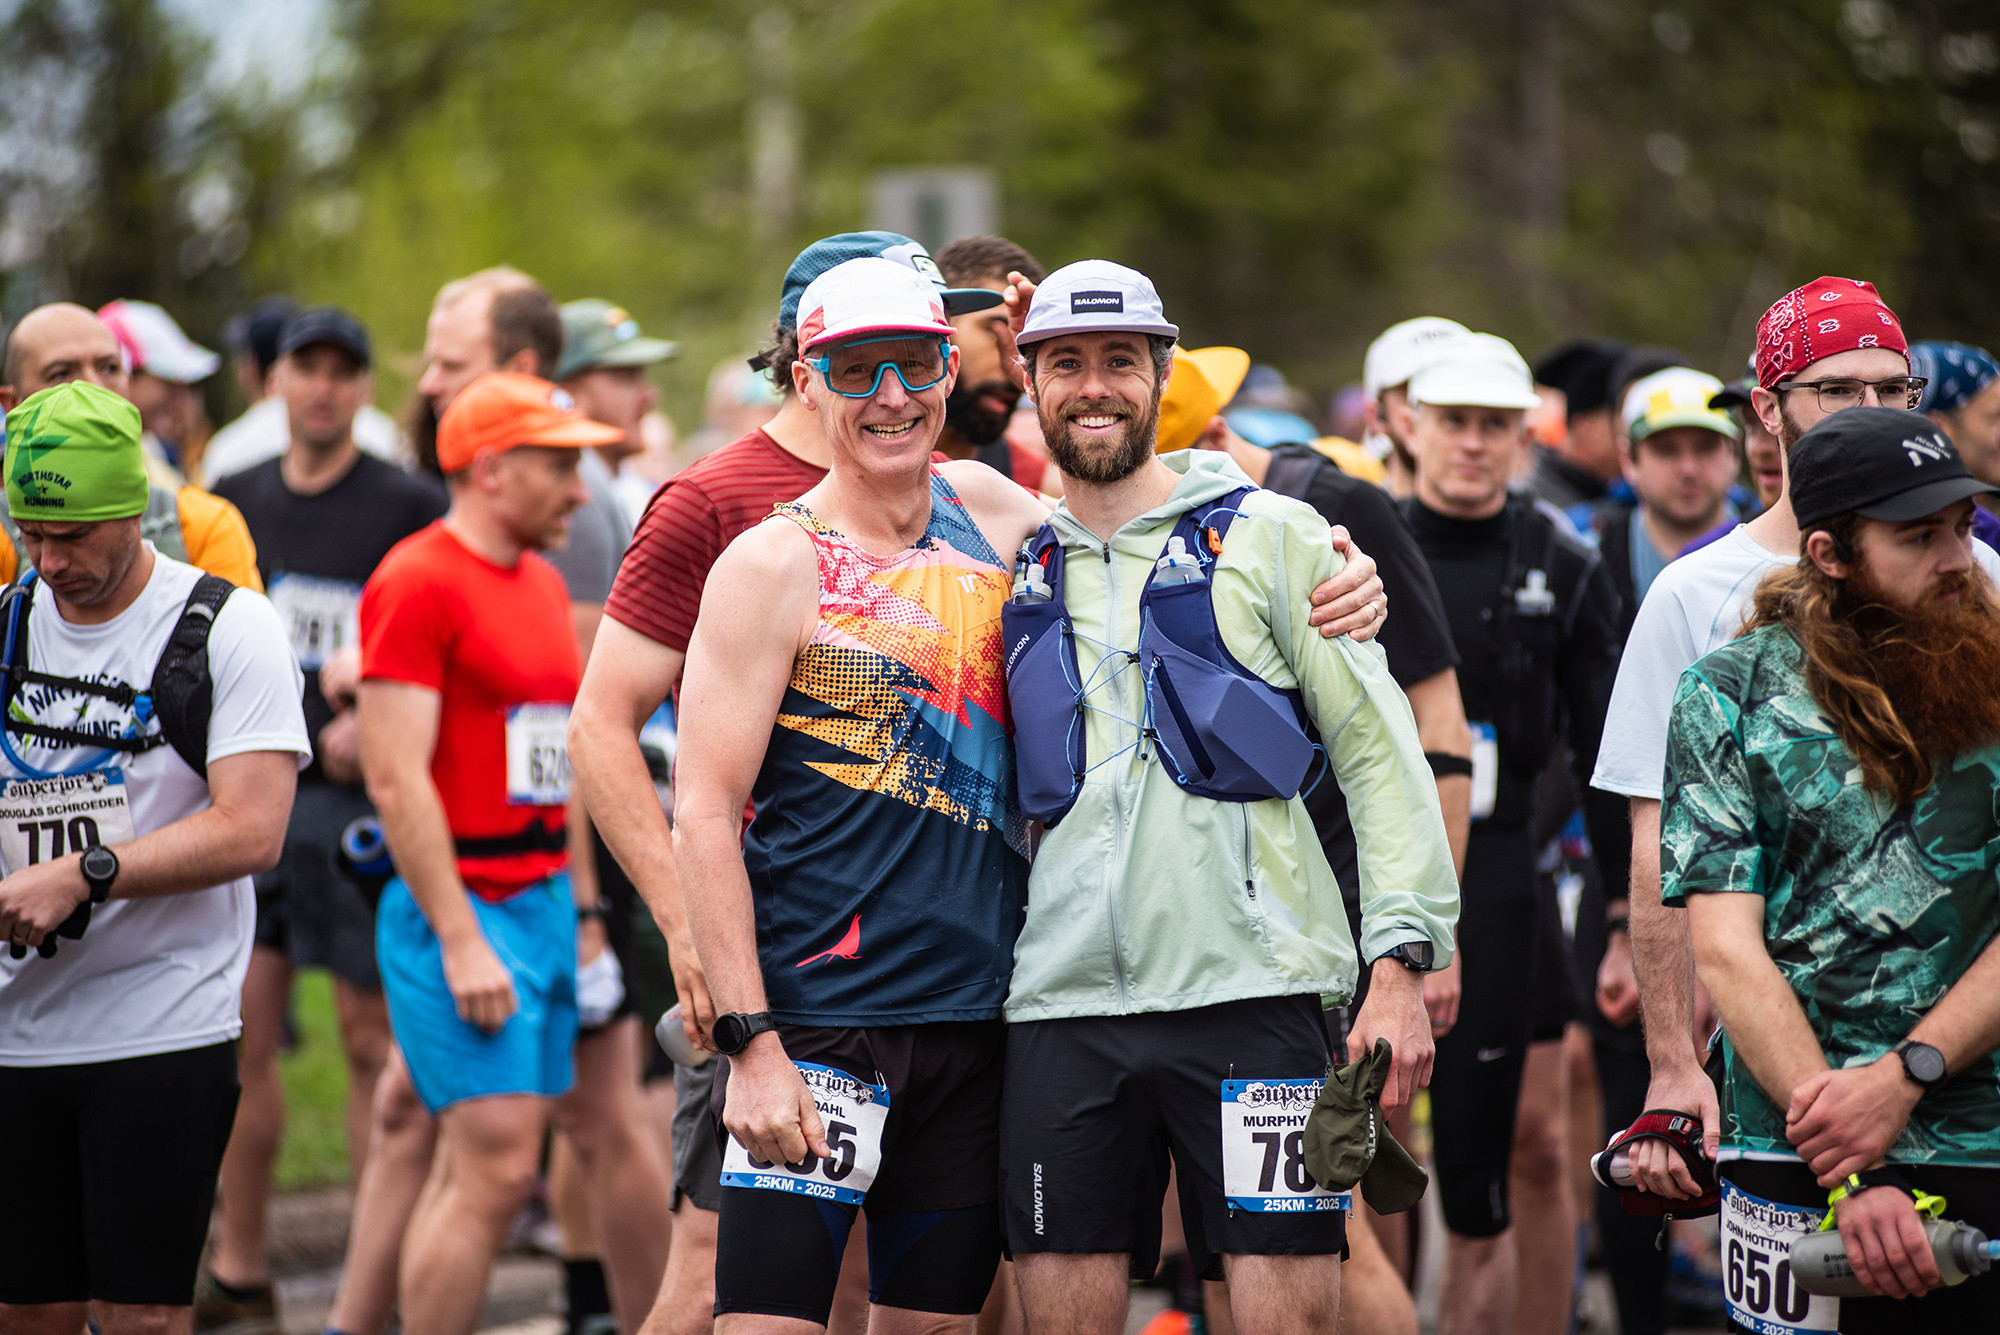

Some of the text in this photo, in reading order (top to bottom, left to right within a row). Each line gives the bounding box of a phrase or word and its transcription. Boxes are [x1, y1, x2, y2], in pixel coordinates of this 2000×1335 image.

[1074, 297, 1120, 306] SALOMON
[17, 470, 72, 490] NORTHSTAR
[24, 496, 65, 508] RUNNING
[0, 797, 125, 819] DOUGLAS SCHROEDER
[18, 815, 101, 868] 770
[1243, 1115, 1307, 1127] MURPHY
[1252, 1131, 1320, 1192] 78
[754, 1175, 795, 1191] 25KM
[804, 1182, 837, 1199] 2025
[1033, 1162, 1044, 1236] SALOMON
[1263, 1199, 1305, 1211] 25KM
[1315, 1198, 1340, 1210] 2025
[1726, 1219, 1791, 1254] JOHN HOTTIN
[1728, 1239, 1810, 1323] 650
[1732, 1307, 1755, 1330] 25KM
